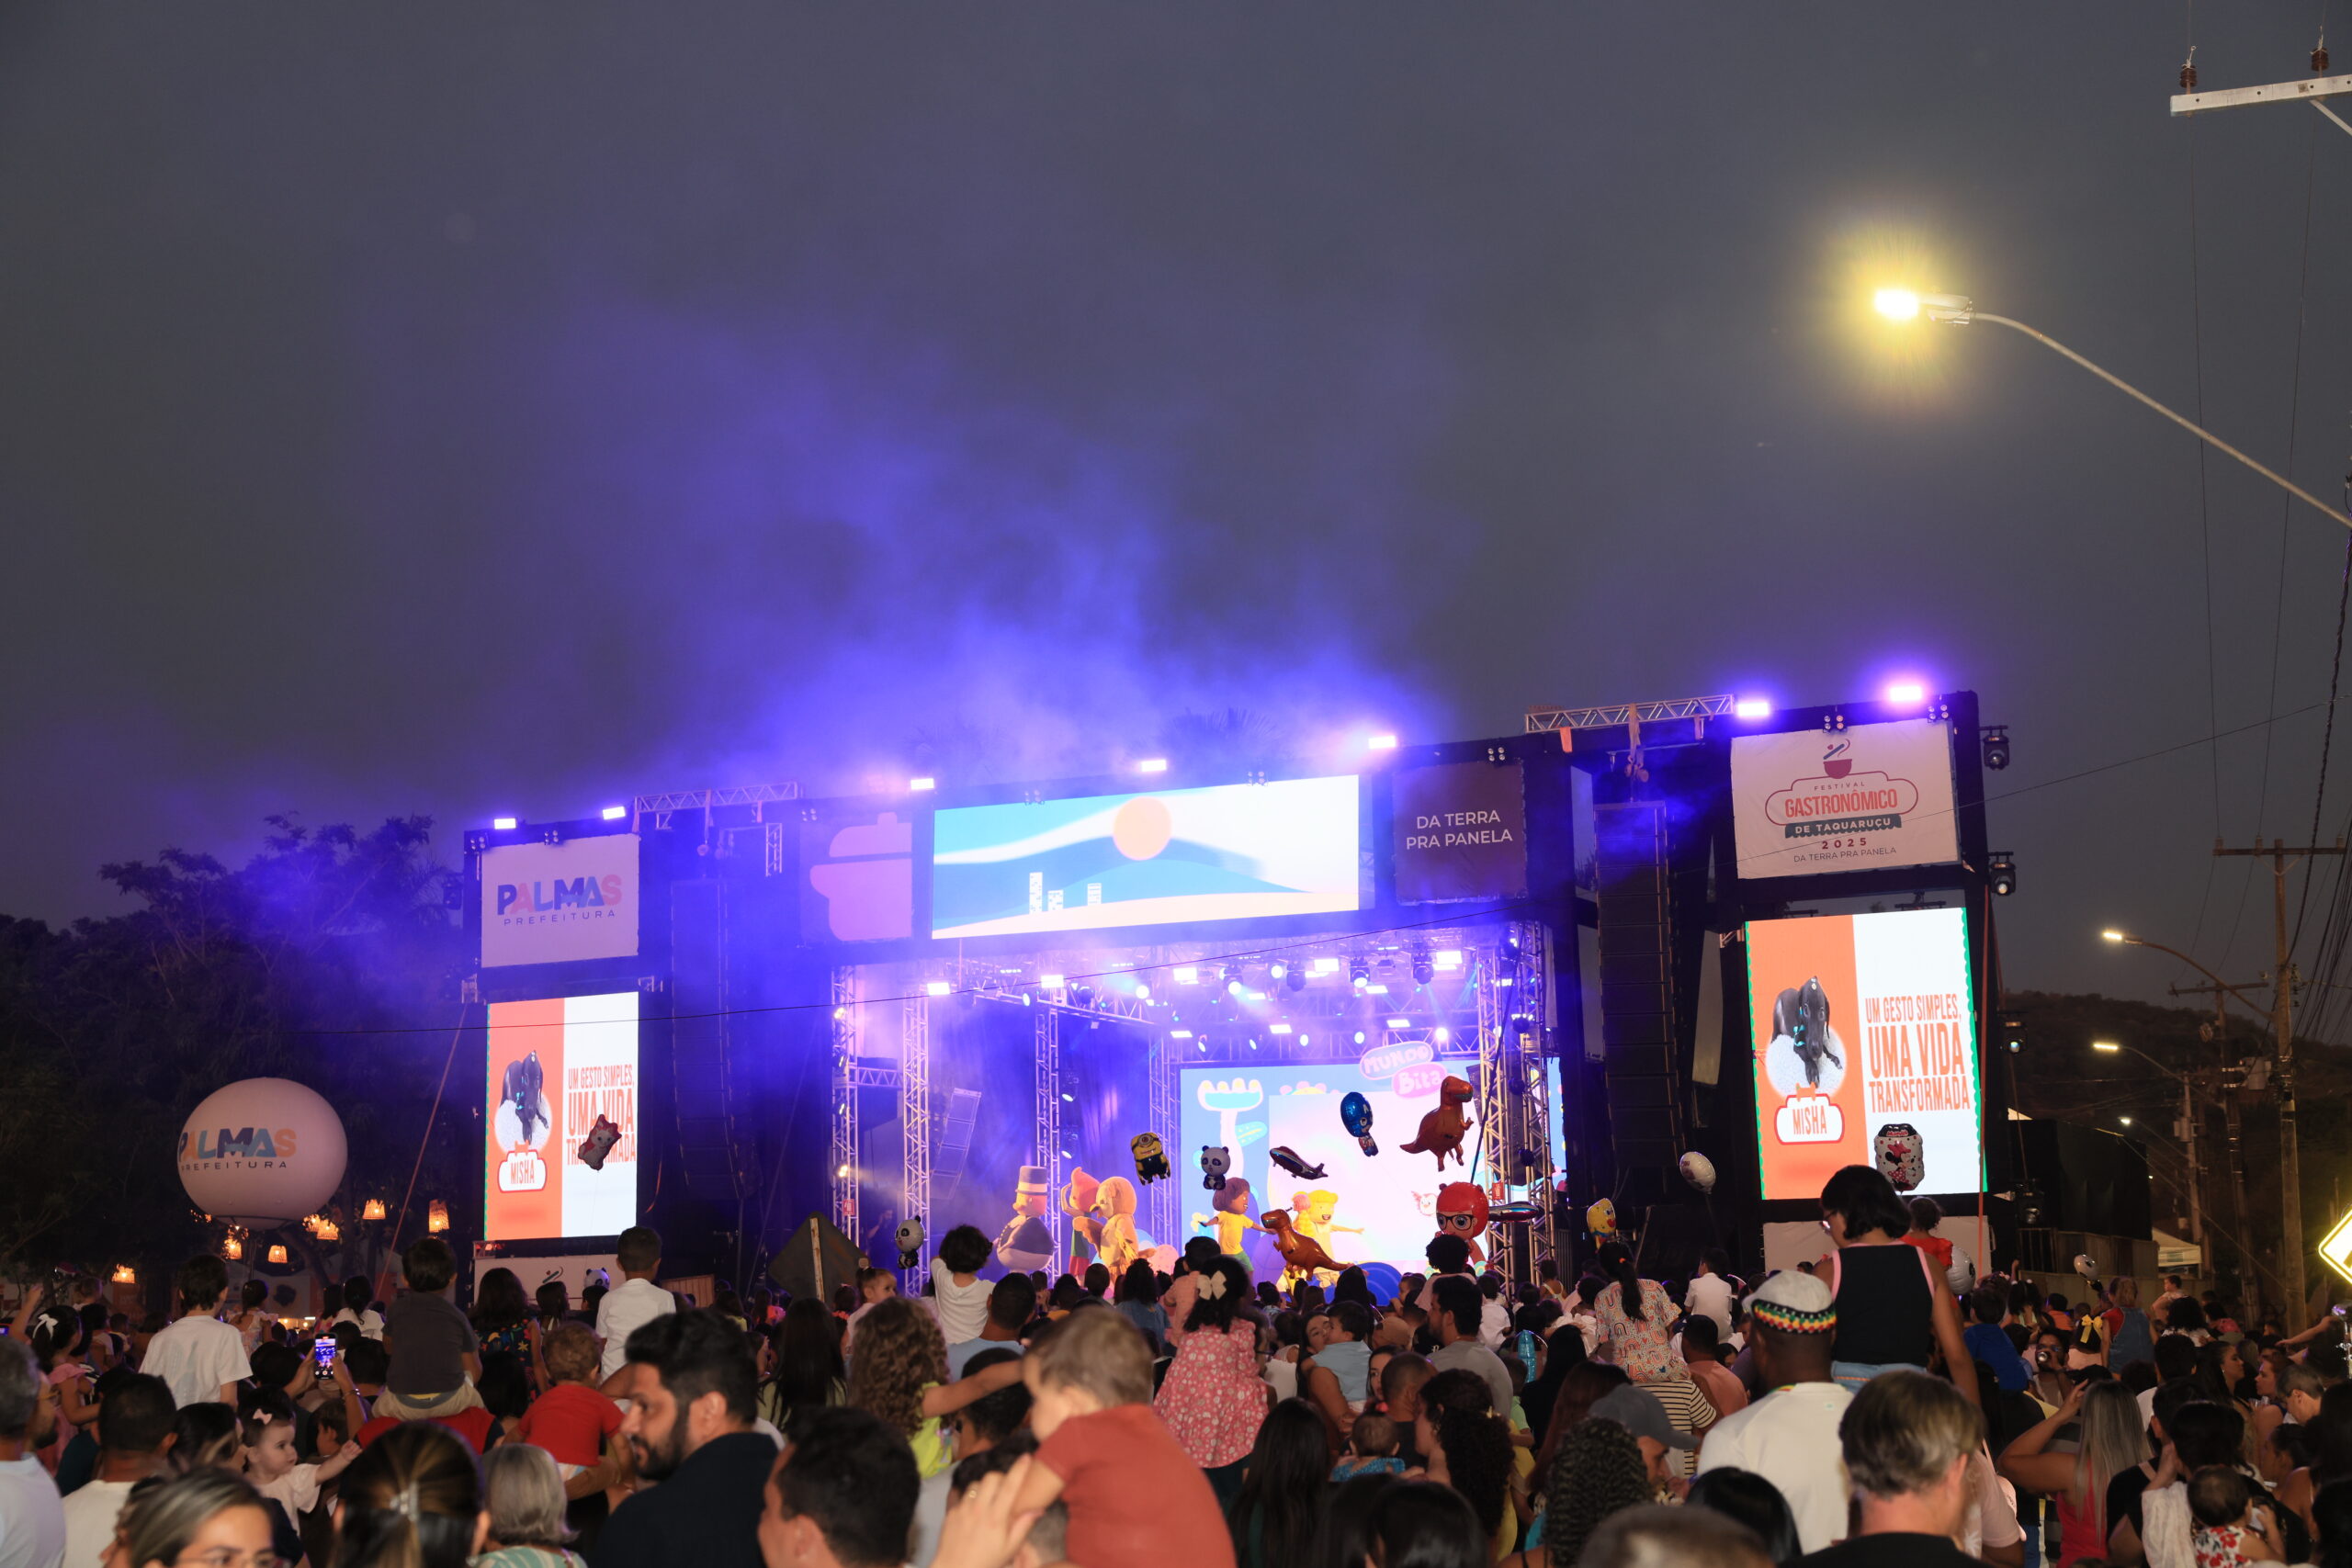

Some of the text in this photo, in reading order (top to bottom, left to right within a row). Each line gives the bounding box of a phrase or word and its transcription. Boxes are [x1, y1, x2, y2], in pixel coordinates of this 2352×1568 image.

[1814, 781, 1866, 791] FESTIVAL
[1785, 788, 1898, 818] GASTRONÔMICO
[1417, 810, 1501, 829] DA TERRA
[1794, 818, 1892, 834] DE TAQUARUÇU
[1406, 829, 1513, 851] PRA PANELA
[1822, 837, 1867, 850] 2025
[1793, 847, 1897, 863] DA TERRA PRA PANELA
[497, 874, 623, 916] PALMAS
[503, 909, 616, 927] PREFEITURA
[1865, 993, 1962, 1023] UM GESTO SIMPLES,
[1363, 1045, 1429, 1074] MUNDO
[1868, 1021, 1965, 1078] UMA VIDA
[568, 1067, 579, 1090] UM
[581, 1066, 602, 1089] GESTO
[1398, 1070, 1441, 1094] Bita
[1869, 1076, 1971, 1113] TRANSFORMADA
[568, 1088, 634, 1136] UMA VIDA
[1792, 1105, 1827, 1135] MISHA
[179, 1127, 297, 1162] PALMAS
[510, 1160, 535, 1186] MISHA
